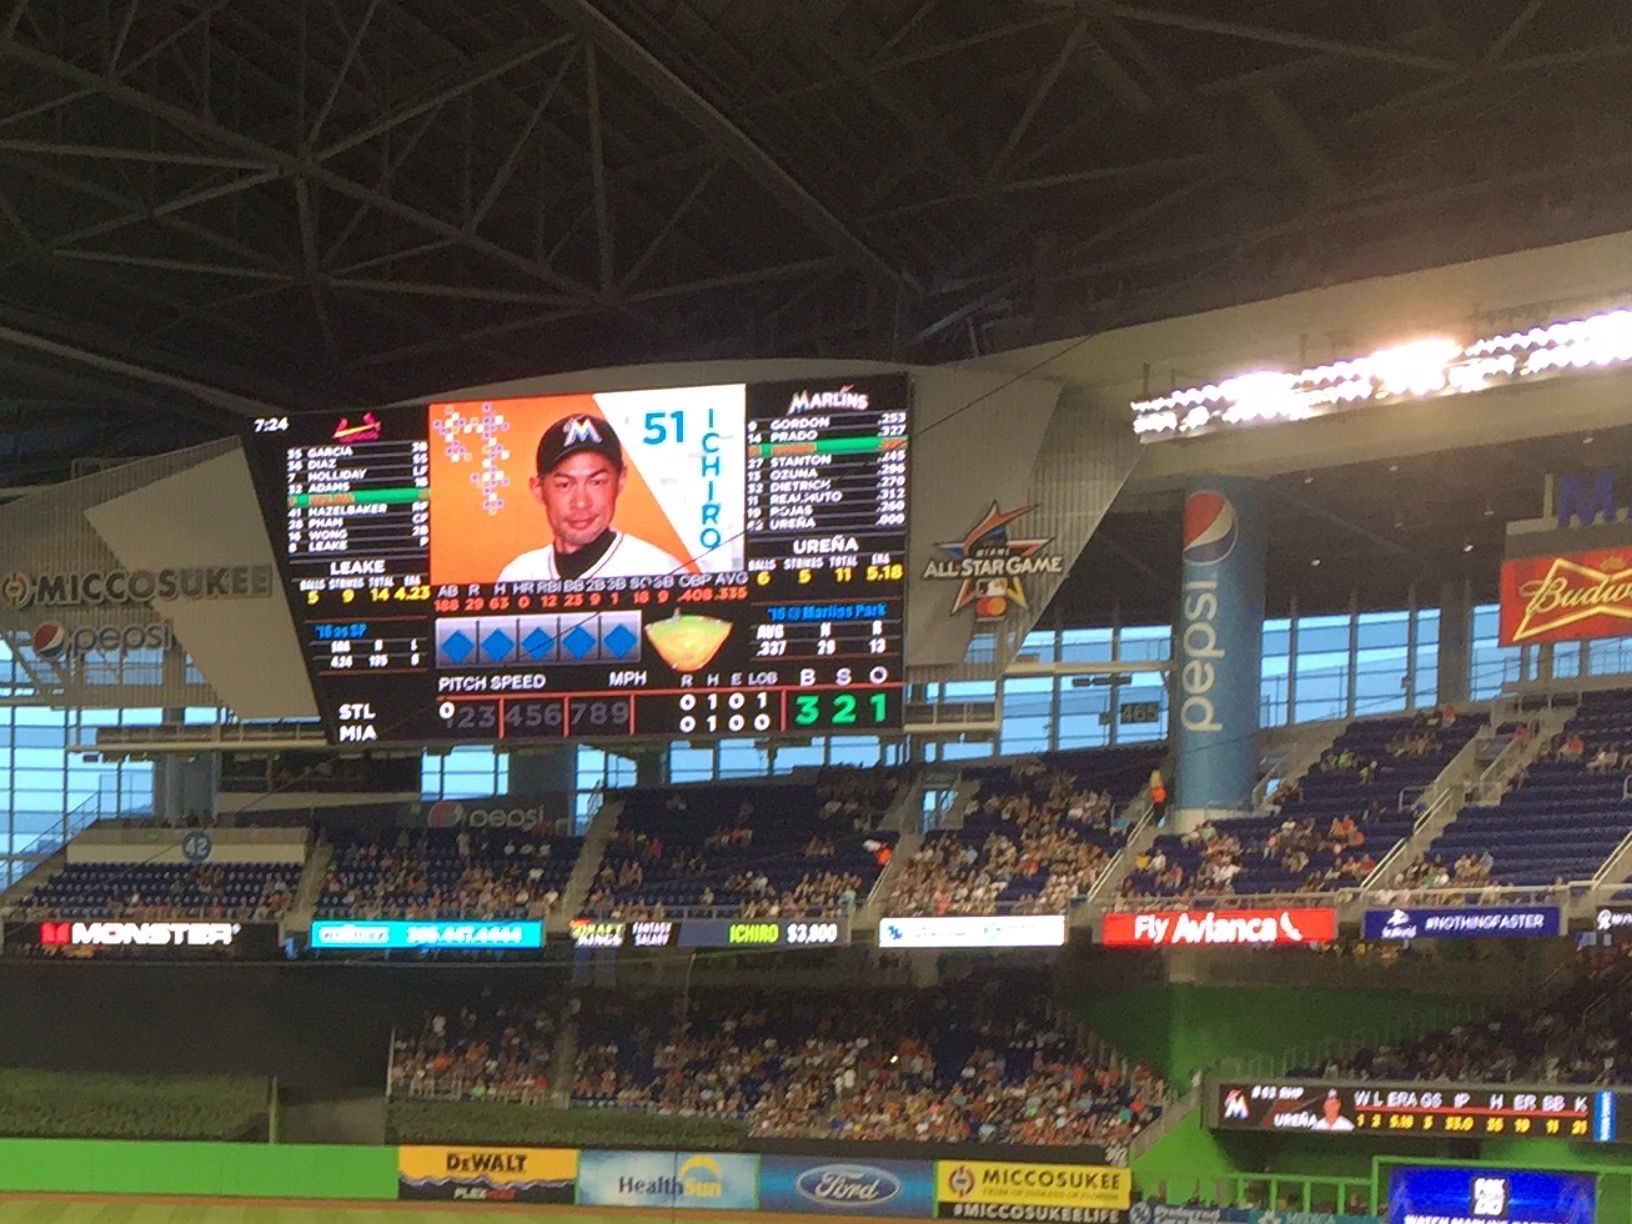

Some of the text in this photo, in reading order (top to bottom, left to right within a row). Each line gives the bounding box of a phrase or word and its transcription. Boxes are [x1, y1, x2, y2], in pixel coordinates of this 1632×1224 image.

[787, 388, 869, 415] MARLINS
[254, 417, 289, 433] 7:24
[643, 410, 685, 446] 51
[770, 416, 830, 430] GORDON
[748, 425, 906, 444] 14 PRADO .327
[307, 446, 353, 458] GARCIA
[748, 454, 832, 469] 27 STANTON
[287, 459, 337, 472] 36 DIAZ
[288, 465, 428, 484] 7 HOLLIDAY LF
[748, 468, 818, 482] 13 OZUNA
[288, 481, 351, 495] 32 ADAMS
[699, 407, 722, 551] ICHIRO
[748, 476, 905, 494] 32 DIETRICH .270
[748, 495, 758, 506] 11
[877, 488, 905, 500] .312
[288, 503, 387, 518] 41 HAZELBAKER
[770, 504, 813, 516] ROJAS
[308, 517, 344, 528] PHAM
[769, 516, 816, 530] UREÑA
[308, 529, 348, 540] WONG
[308, 536, 428, 552] LEAKE P
[793, 535, 859, 554] UREÑA
[330, 560, 386, 576] LEAKE
[1006, 555, 1063, 575] GAME
[37, 565, 272, 603] MICCOSUKEE
[437, 571, 748, 598] AB R H HR RBI OBP AVG
[757, 564, 903, 586] 6 5 11 5.18
[307, 585, 431, 604] 5 9 14 4.23
[518, 591, 619, 609] 0 12 23 1
[802, 602, 887, 620] Marlins Park
[71, 619, 174, 658] pepsi
[1180, 580, 1226, 733] pepsi
[438, 671, 647, 692] PITCH SPEED MPH
[680, 666, 887, 688] R H E LOB B S O
[338, 692, 767, 721] STL 0 0 1 0 1
[458, 693, 887, 728] 2 3 4 5 6 7 8 9 3 2 1
[1122, 705, 1159, 723] 465
[339, 713, 770, 742] MIA 0 1 0 0
[470, 806, 544, 833] pepsi
[185, 837, 208, 856] 42
[1134, 911, 1276, 943] Fly Avianca
[1425, 914, 1545, 931] #NOTHINGFASTER
[71, 922, 237, 945] MONSTER
[729, 924, 778, 943] ICHIRO
[1354, 1090, 1588, 1112] W L ERA IP H ER K
[1546, 1119, 1560, 1134] 11
[815, 1172, 880, 1201] Ford
[982, 1169, 1120, 1190] MICCOSUKEE
[953, 1203, 1120, 1224] #MICCOSUKEELIFE
